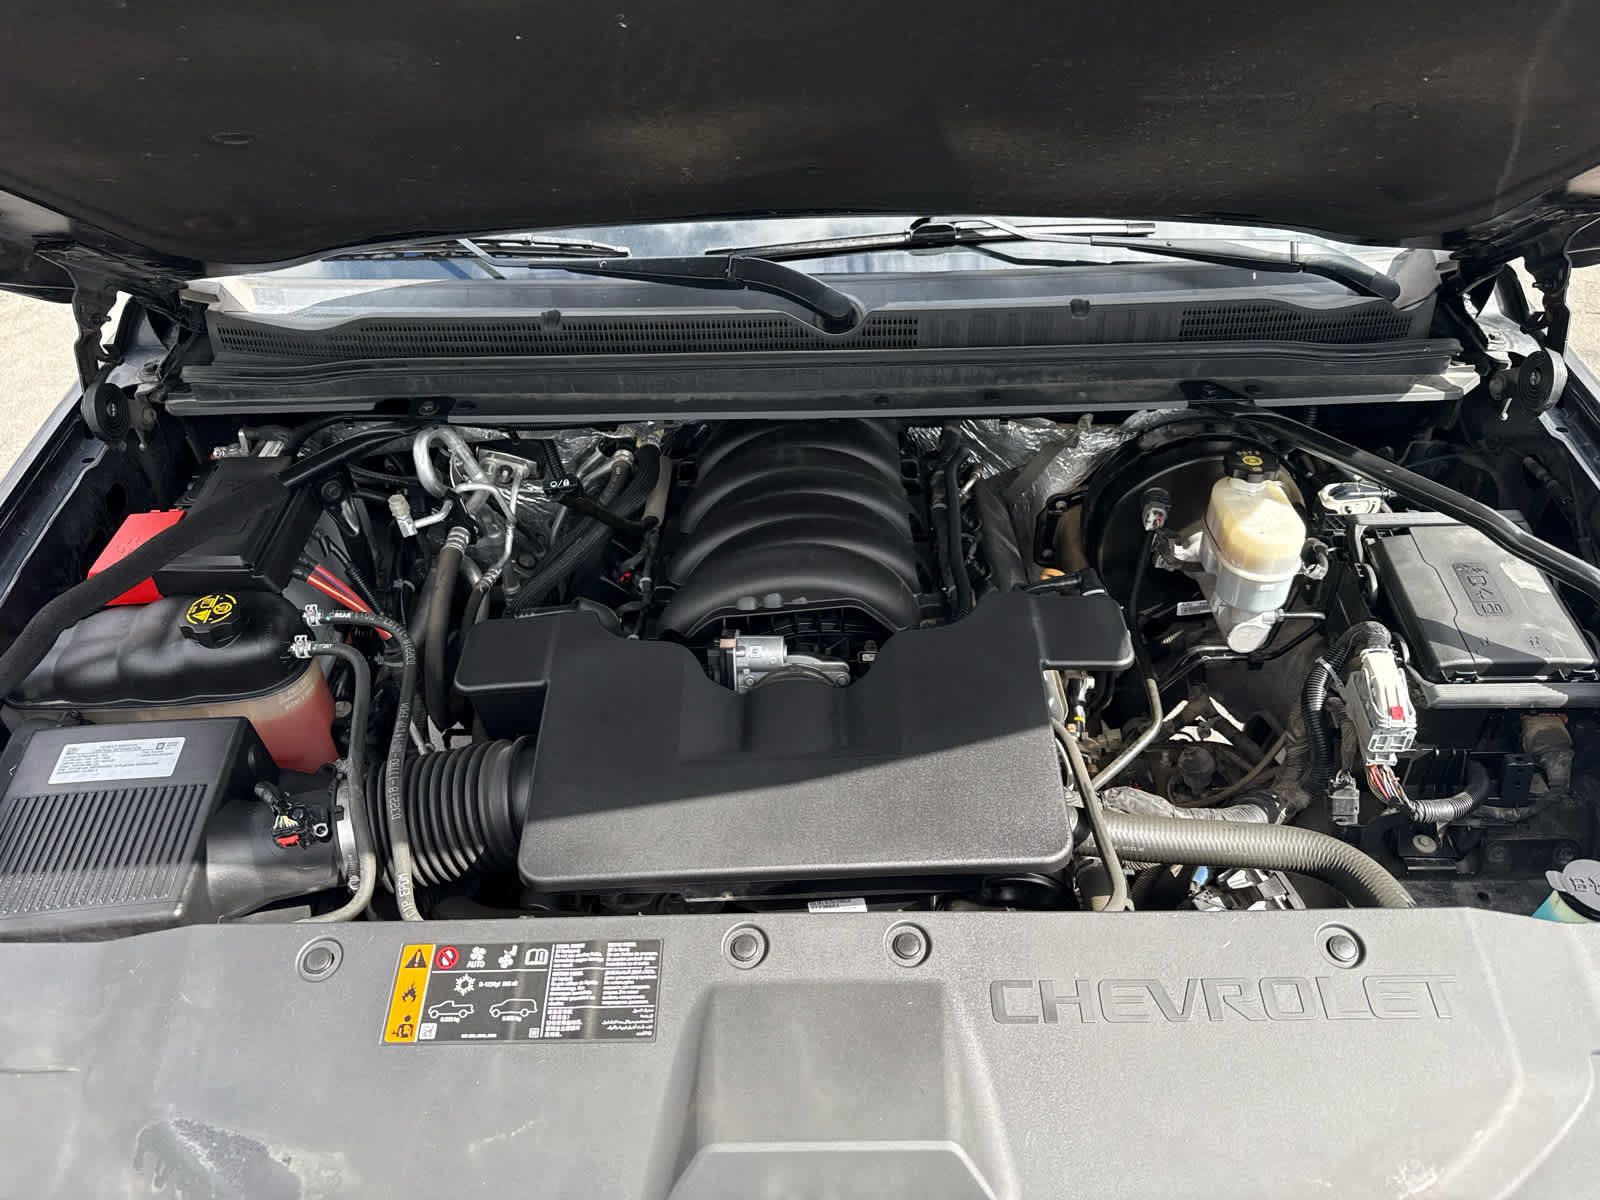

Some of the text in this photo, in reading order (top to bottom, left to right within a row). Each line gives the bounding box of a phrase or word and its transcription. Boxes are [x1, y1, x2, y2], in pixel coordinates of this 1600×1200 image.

[397, 872, 410, 897] EPDM
[466, 960, 486, 968] AUTO
[989, 975, 1457, 1024] CHEVROLET
